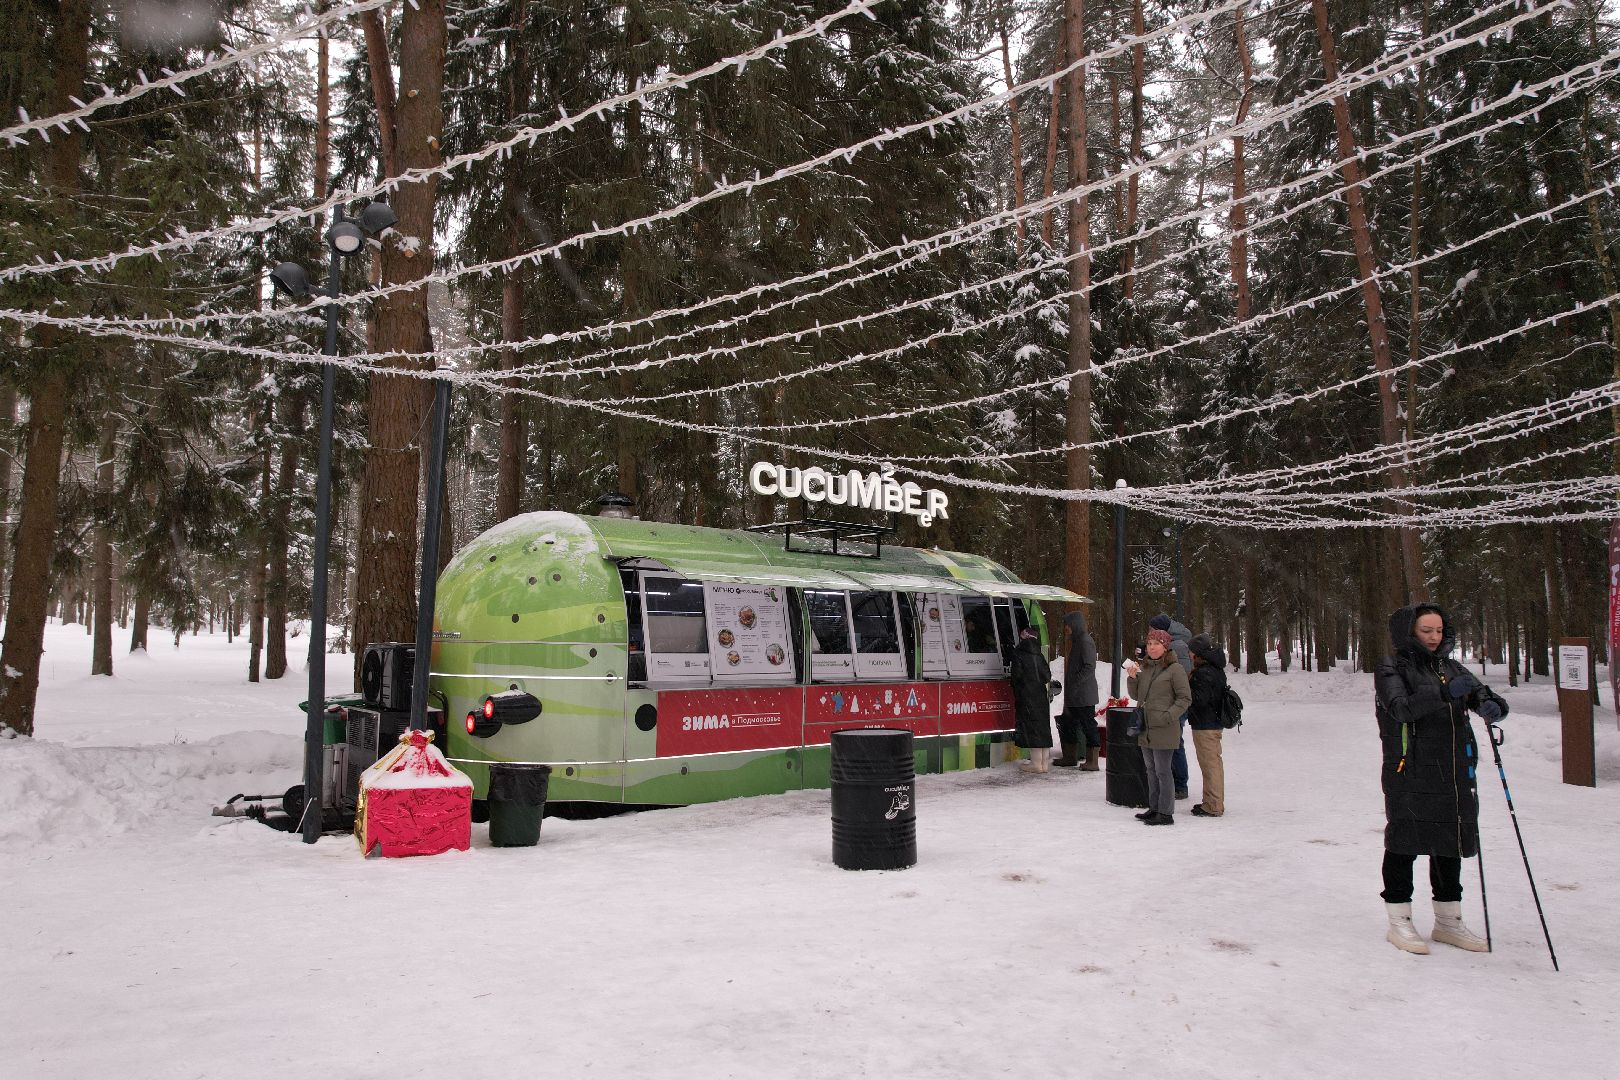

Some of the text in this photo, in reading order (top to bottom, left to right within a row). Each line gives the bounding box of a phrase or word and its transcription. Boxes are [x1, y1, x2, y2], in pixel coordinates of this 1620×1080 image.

[946, 701, 978, 715] ЗИМА
[682, 714, 730, 731] ЗИМА
[737, 716, 781, 725] Подмосковье
